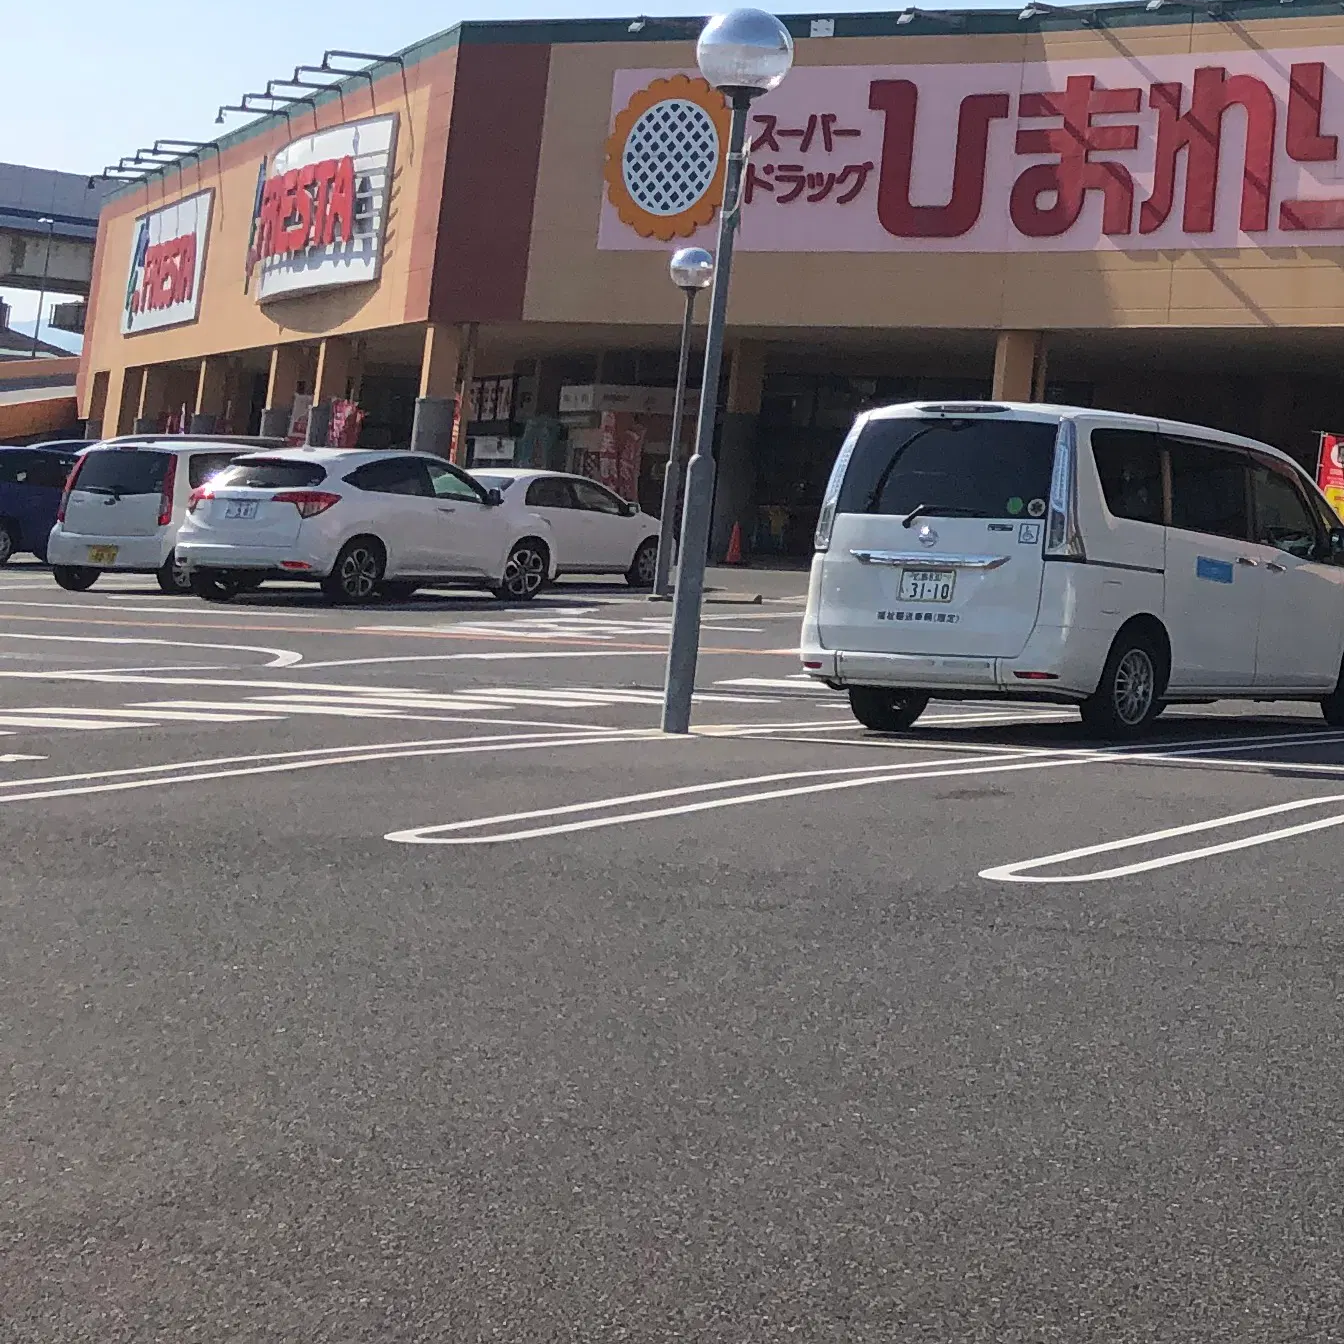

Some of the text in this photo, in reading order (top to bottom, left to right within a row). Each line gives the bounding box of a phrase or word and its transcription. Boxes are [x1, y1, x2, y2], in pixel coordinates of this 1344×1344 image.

[750, 113, 861, 153] スーパー
[744, 161, 874, 205] ドラッグ
[909, 583, 950, 599] 31-10
